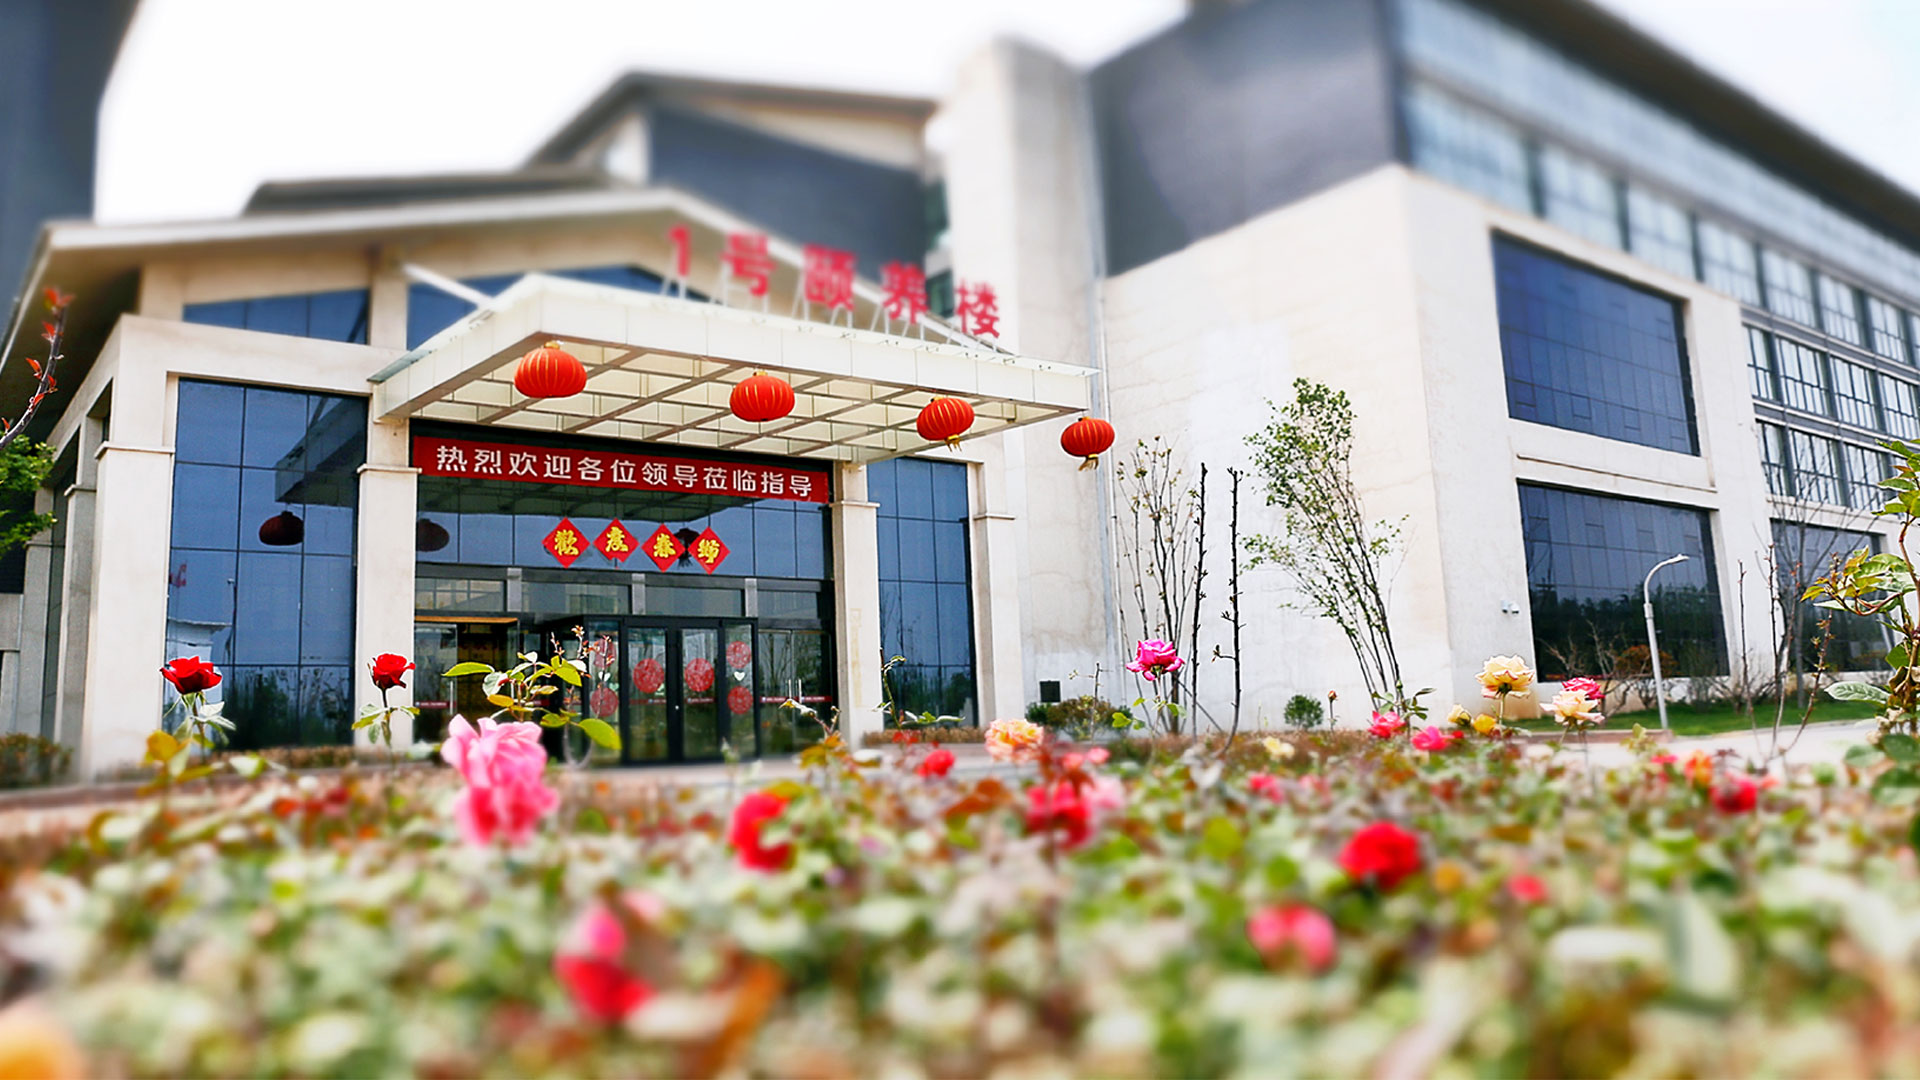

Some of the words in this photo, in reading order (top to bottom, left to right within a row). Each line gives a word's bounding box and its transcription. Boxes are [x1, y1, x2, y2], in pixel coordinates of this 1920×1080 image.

[669, 225, 1000, 338] 1号颐养楼
[437, 445, 812, 497] 热烈欢迎各位领导莅临指导
